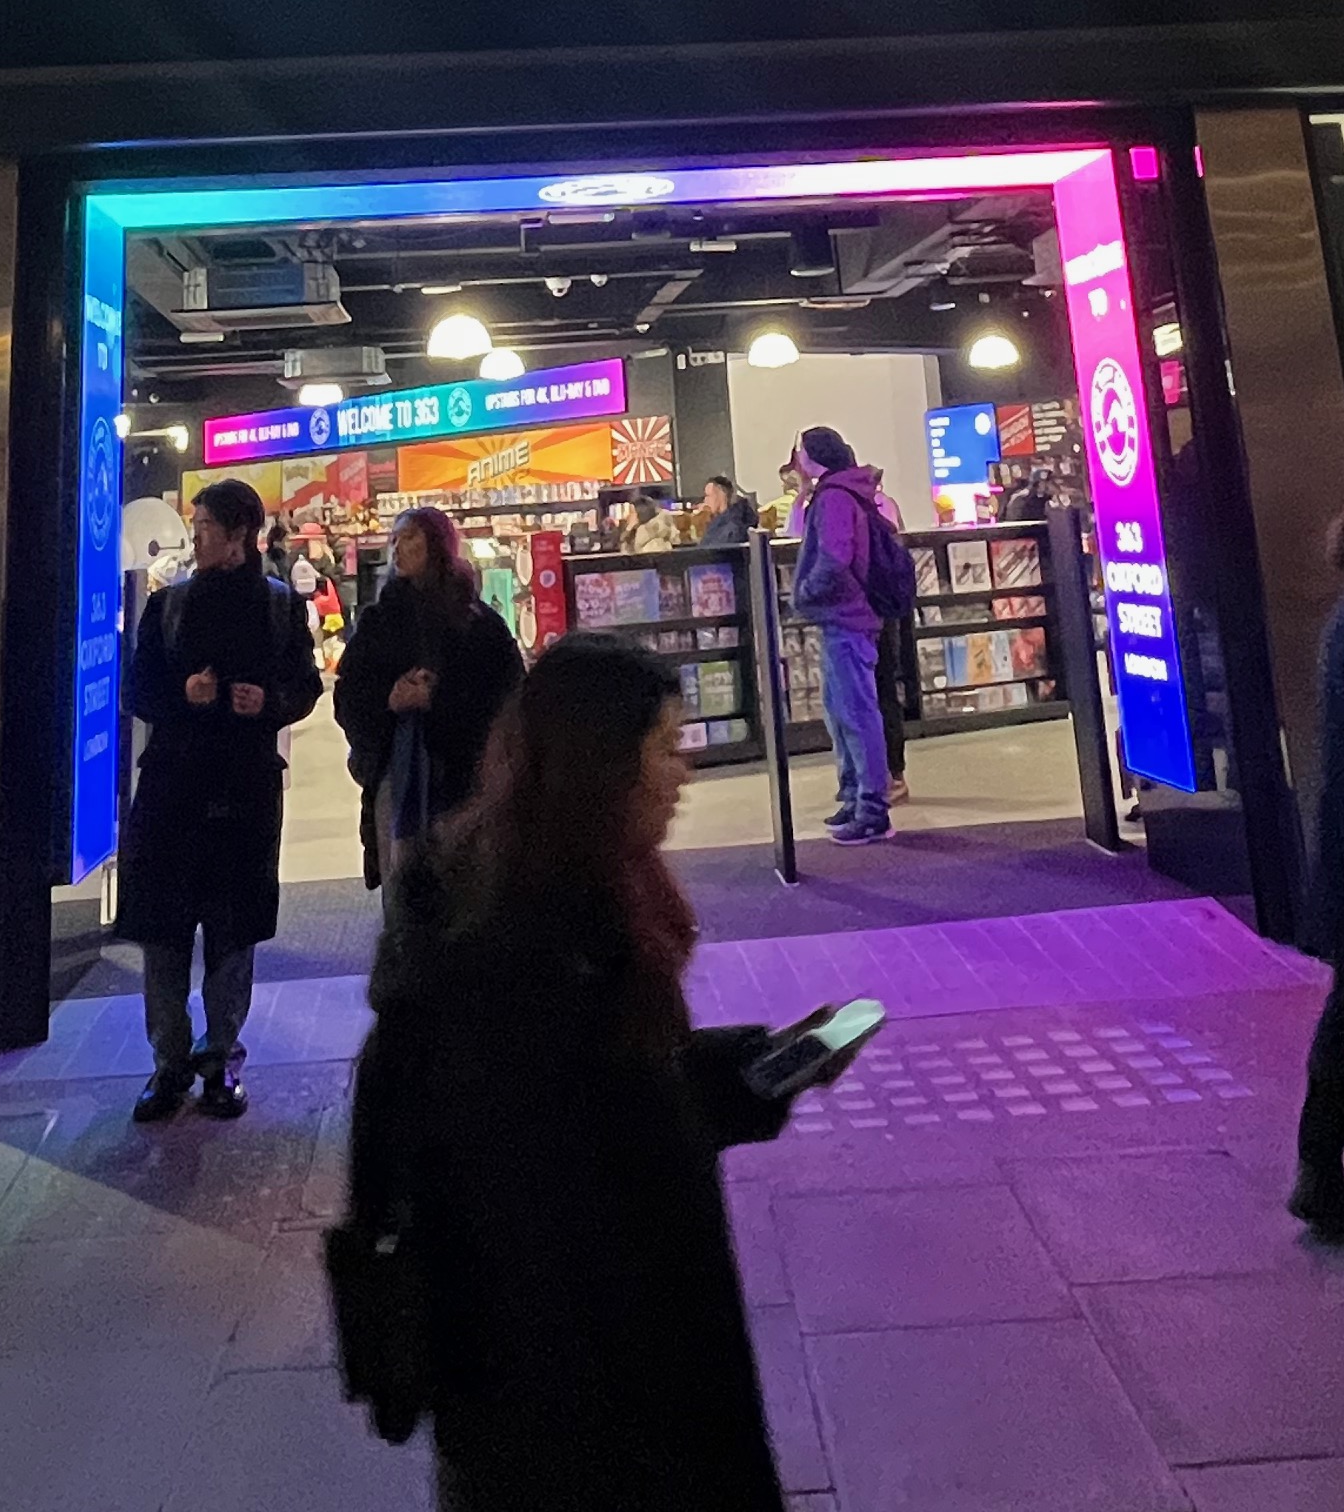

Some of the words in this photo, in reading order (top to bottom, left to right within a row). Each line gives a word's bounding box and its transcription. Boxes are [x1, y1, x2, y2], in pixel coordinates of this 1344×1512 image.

[337, 401, 394, 437] WELCOME
[395, 399, 412, 429] TO
[414, 396, 440, 427] 363
[466, 439, 532, 489] ANIME
